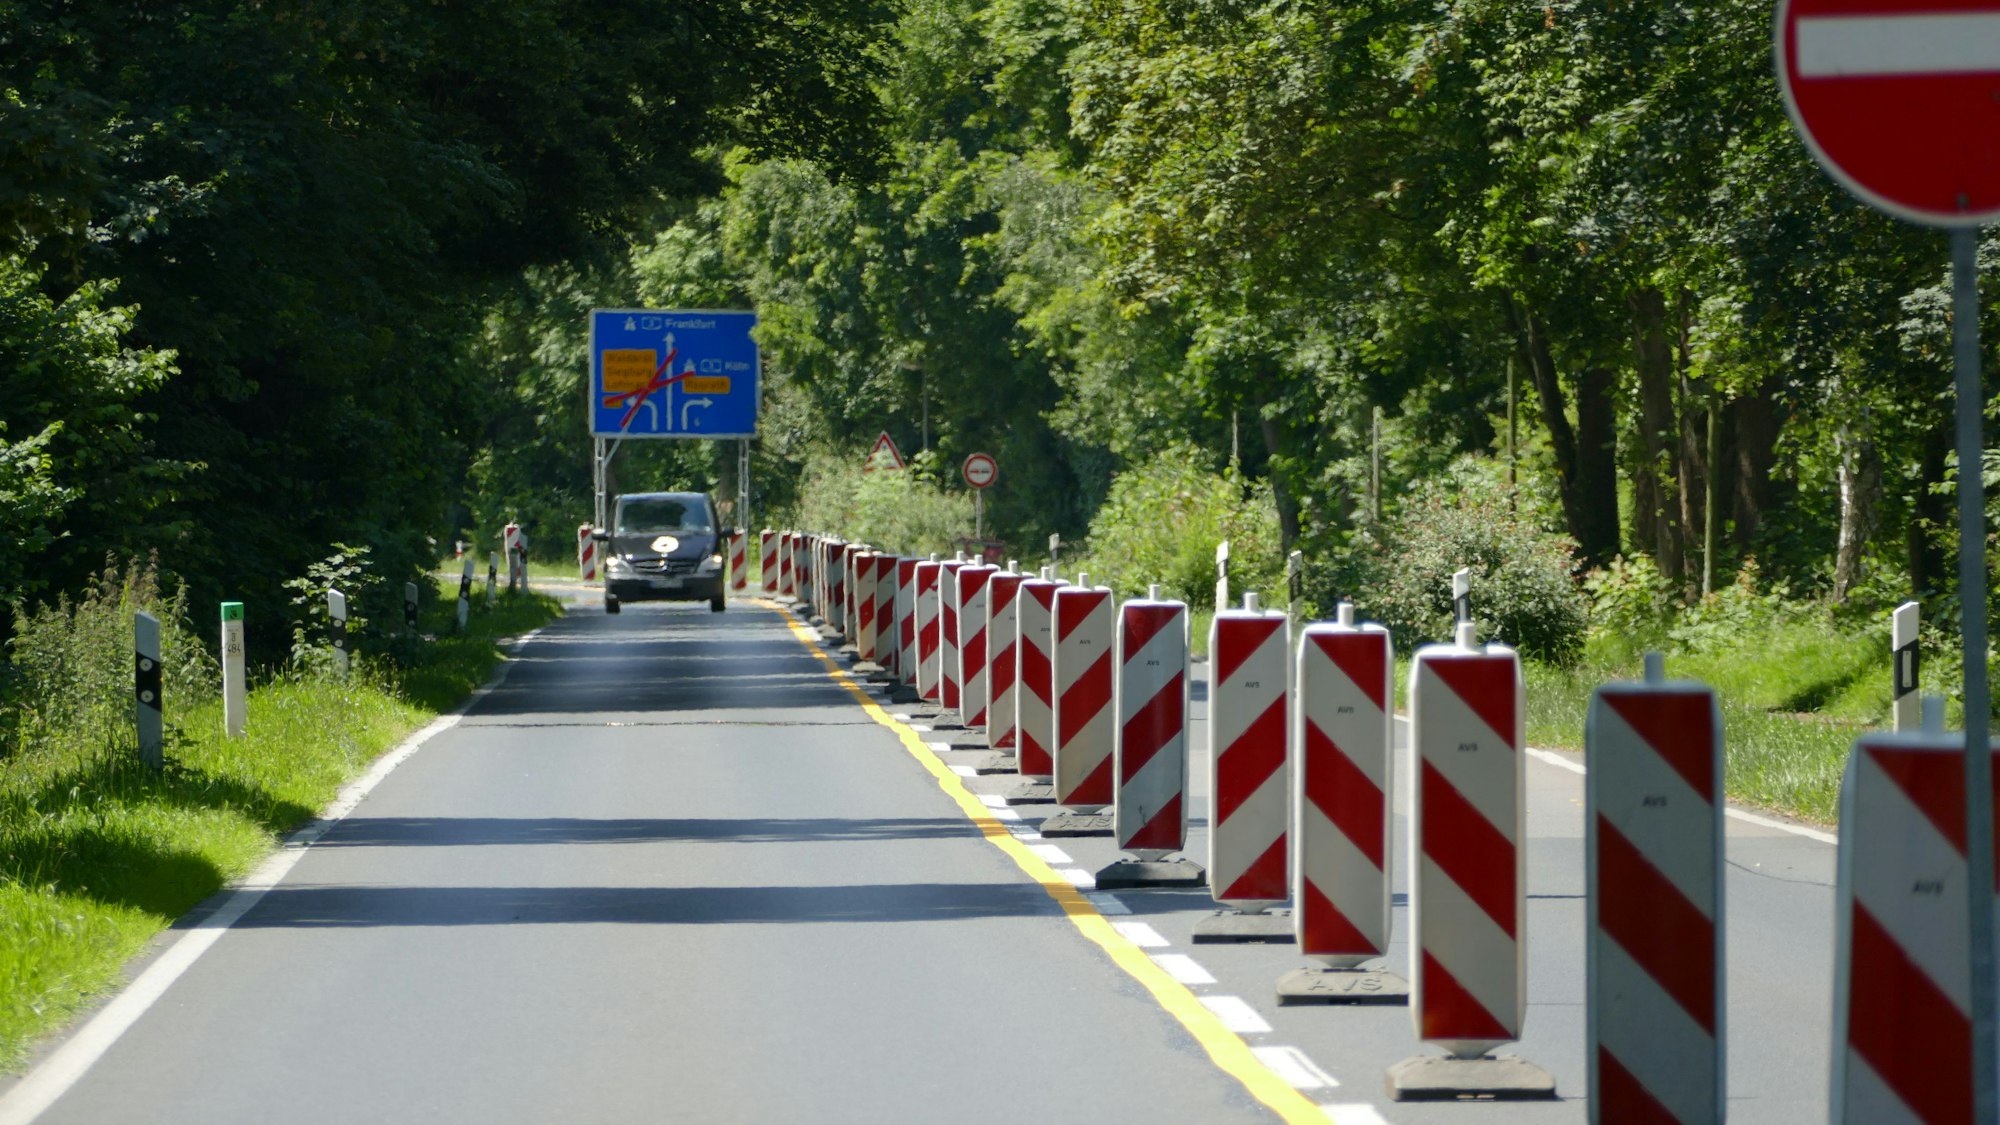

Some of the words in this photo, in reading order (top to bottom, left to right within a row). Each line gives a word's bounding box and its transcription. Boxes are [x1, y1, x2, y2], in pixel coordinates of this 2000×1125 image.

[665, 318, 717, 329] Frankfurt
[227, 643, 241, 654] 484
[1244, 681, 1260, 689] AVS
[1457, 743, 1479, 752] AVS
[1641, 795, 1668, 807] AVS
[1911, 879, 1945, 896] AVS
